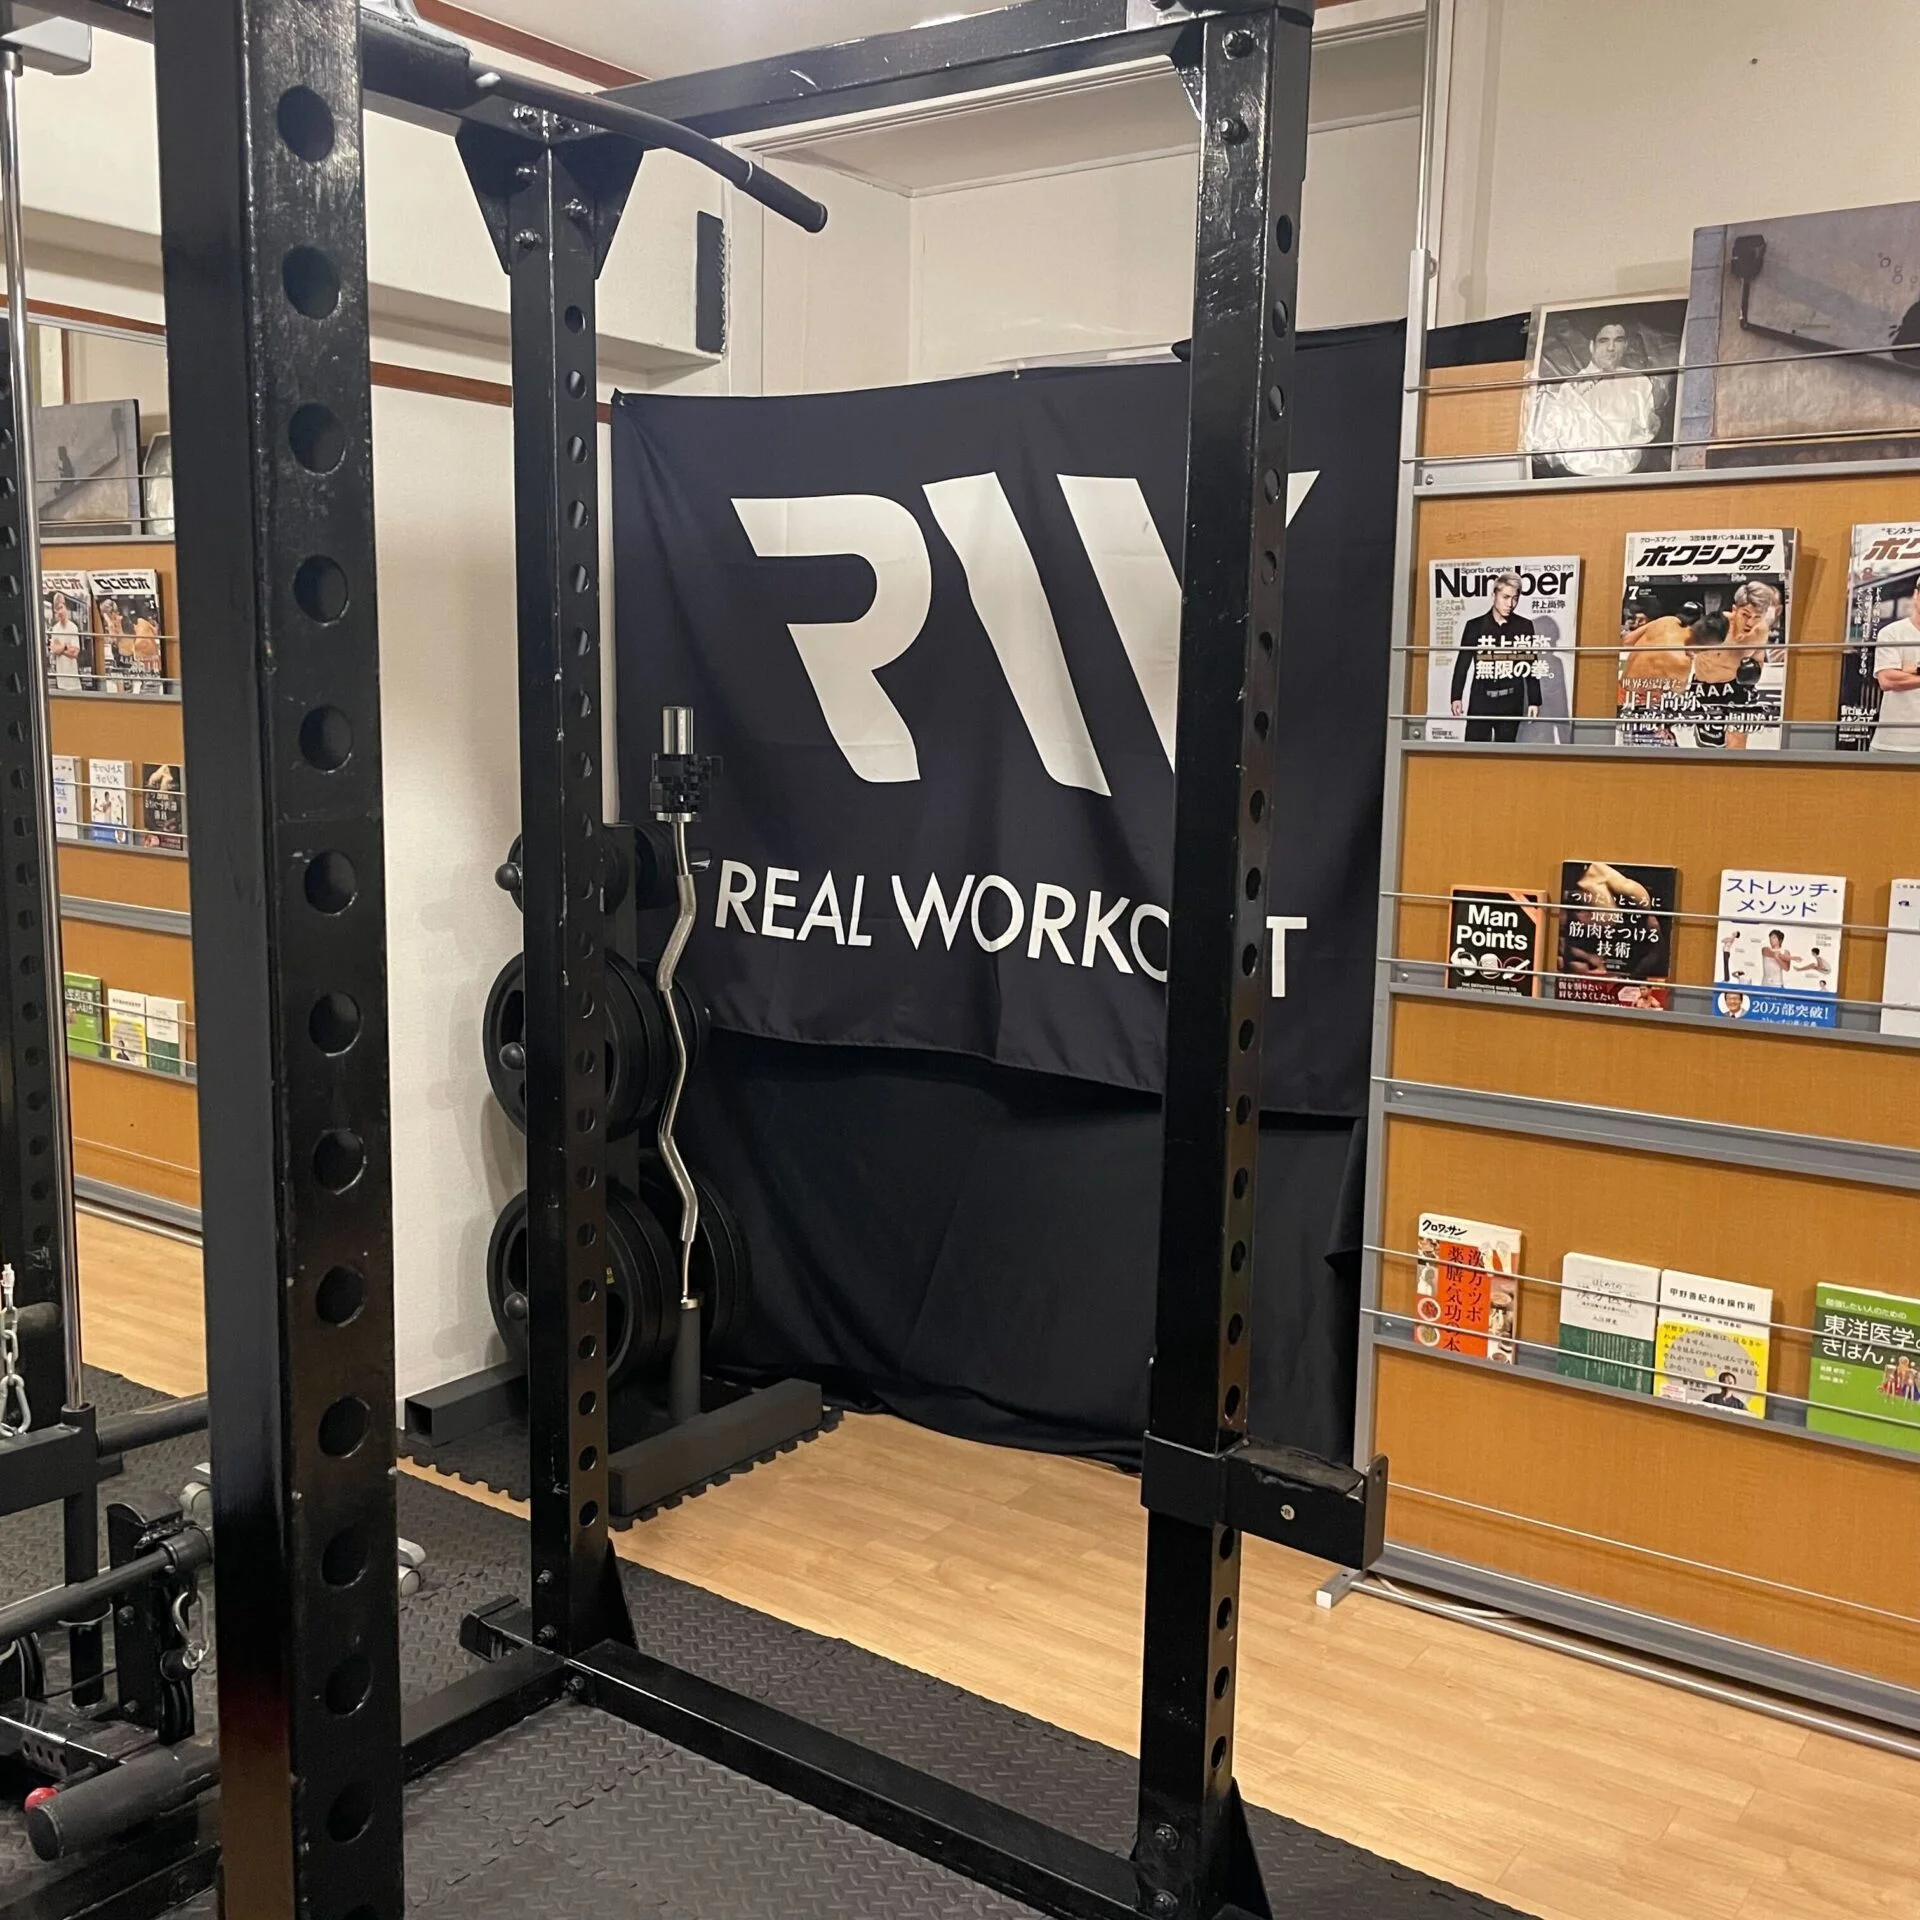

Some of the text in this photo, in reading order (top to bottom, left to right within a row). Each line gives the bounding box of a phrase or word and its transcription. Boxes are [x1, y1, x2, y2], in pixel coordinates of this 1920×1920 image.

[1636, 544, 1775, 567] ボクシング
[1628, 586, 1639, 600] 7
[1531, 600, 1566, 609] 井上尚弥
[1477, 634, 1551, 654] 井上尚弥
[1476, 660, 1555, 680] 無限の拳。
[1571, 892, 1661, 907] つけたいところに
[1737, 899, 1819, 917] メソッド
[1468, 904, 1518, 928] Man
[714, 859, 1308, 998] REAL WORKOT
[1456, 925, 1528, 950] Points
[1568, 921, 1660, 943] 筋肉をつける
[1596, 940, 1631, 958] 技術
[1421, 1219, 1467, 1236] クロワッサン
[1824, 1314, 1920, 1349] 東洋医学
[1821, 1338, 1884, 1365] きほん
